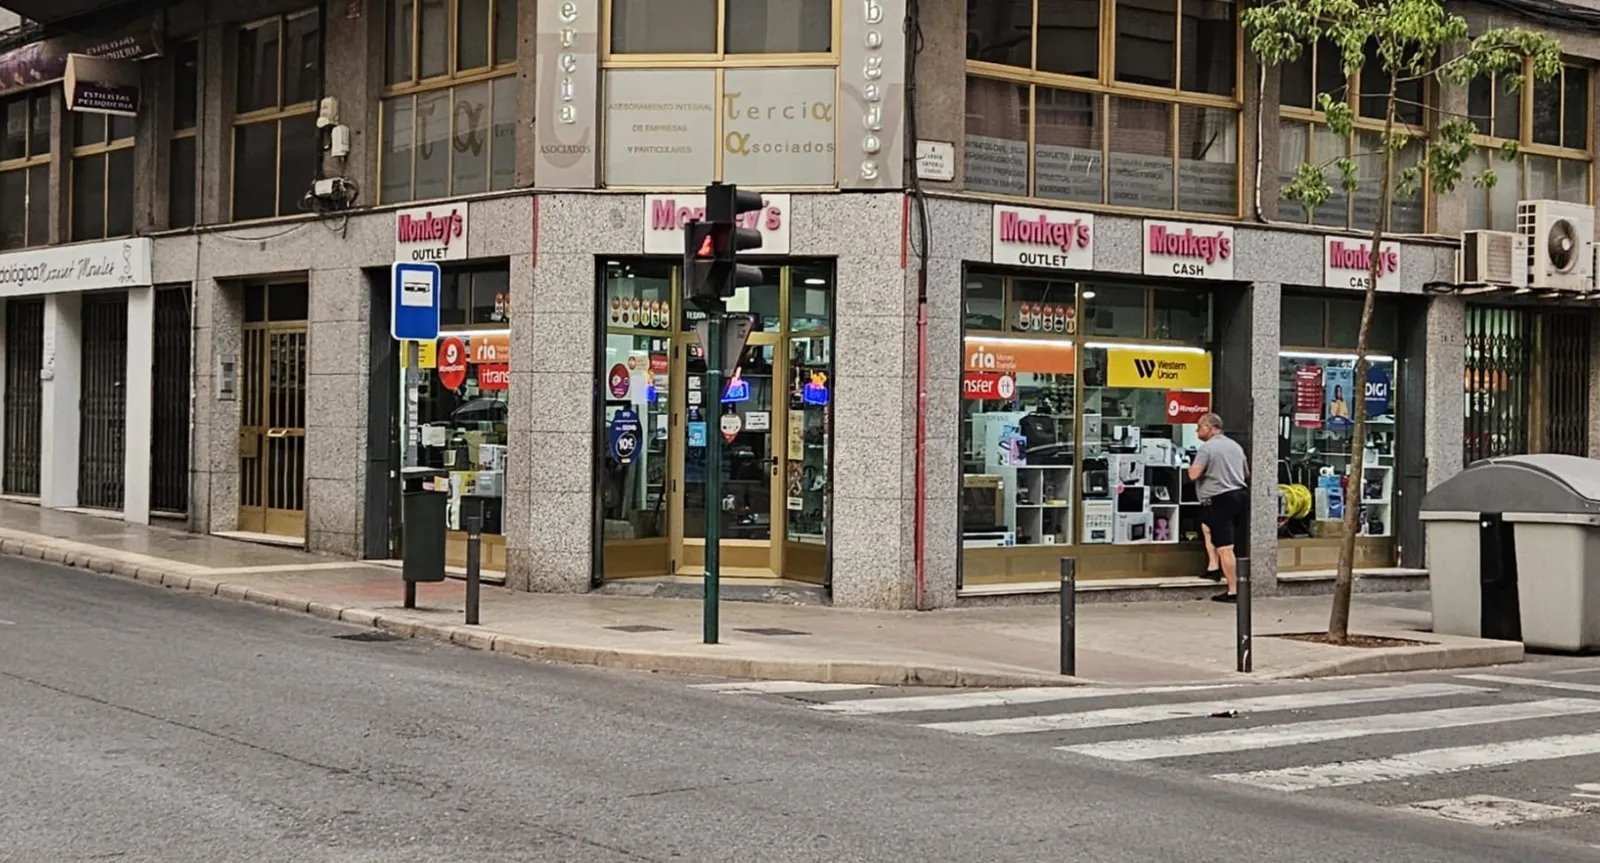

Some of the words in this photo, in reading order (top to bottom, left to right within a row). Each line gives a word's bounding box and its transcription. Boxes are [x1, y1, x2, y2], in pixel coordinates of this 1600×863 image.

[84, 91, 130, 101] ESTILISTAS
[78, 98, 133, 109] PELUQUERIA
[632, 124, 643, 132] DE
[645, 124, 687, 132] EMPRESAS
[540, 145, 591, 154] ASOCIADOS
[652, 199, 781, 230] Moey's
[398, 209, 463, 246] Monkey's
[1000, 211, 1090, 252] Monkey's
[1150, 225, 1230, 264] Monkey's
[412, 247, 449, 261] OUTLET
[1018, 252, 1069, 267] OUTLET
[1330, 241, 1397, 278] Monky's
[1172, 263, 1204, 276] CASH
[1349, 277, 1370, 288] CAS
[477, 338, 496, 360] ria
[970, 345, 995, 368] ria
[1158, 360, 1186, 369] Western
[1158, 370, 1178, 379] Union
[1365, 382, 1387, 396] DIGI
